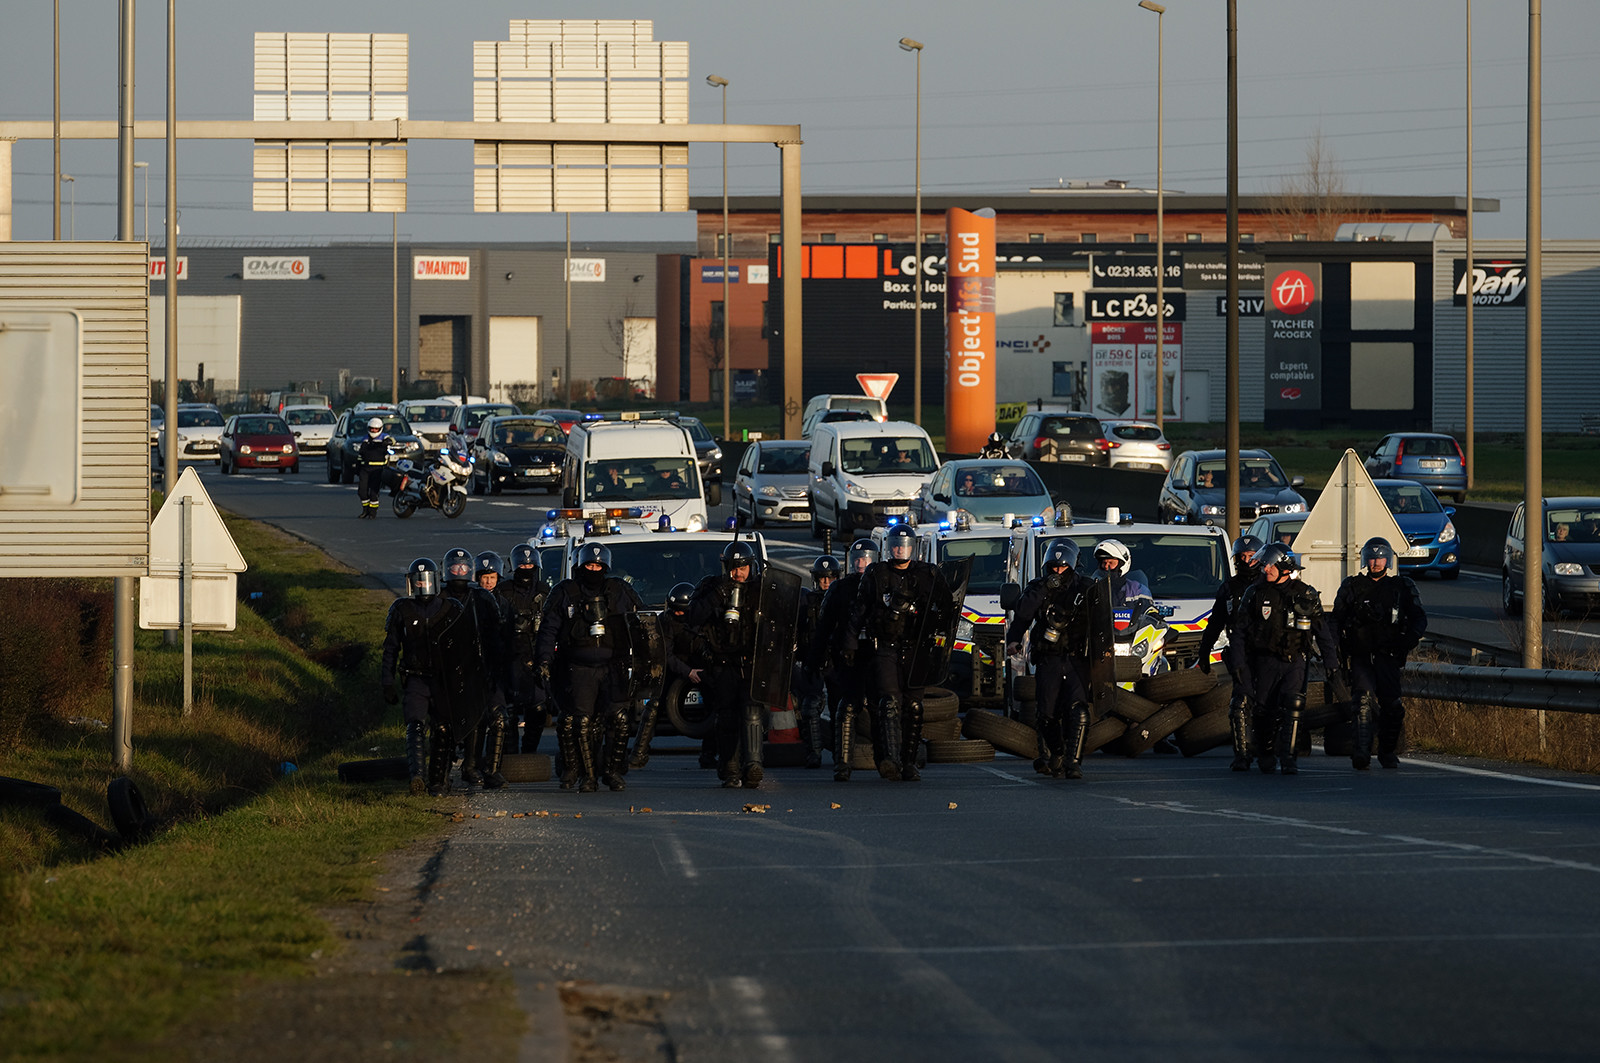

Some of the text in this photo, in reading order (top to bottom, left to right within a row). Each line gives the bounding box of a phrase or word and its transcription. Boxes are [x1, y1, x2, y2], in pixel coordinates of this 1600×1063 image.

[958, 233, 979, 272] Sud
[425, 261, 467, 275] MANITOU
[884, 280, 910, 292] Box
[1456, 268, 1527, 302] Dafy
[883, 300, 937, 310] Particuiers
[1472, 295, 1502, 305] MOTO
[1270, 320, 1314, 329] TACHER
[1273, 331, 1312, 339] ACOGEX
[1280, 362, 1308, 371] Experts
[1270, 371, 1314, 381] comptables
[999, 405, 1025, 420] DAFY
